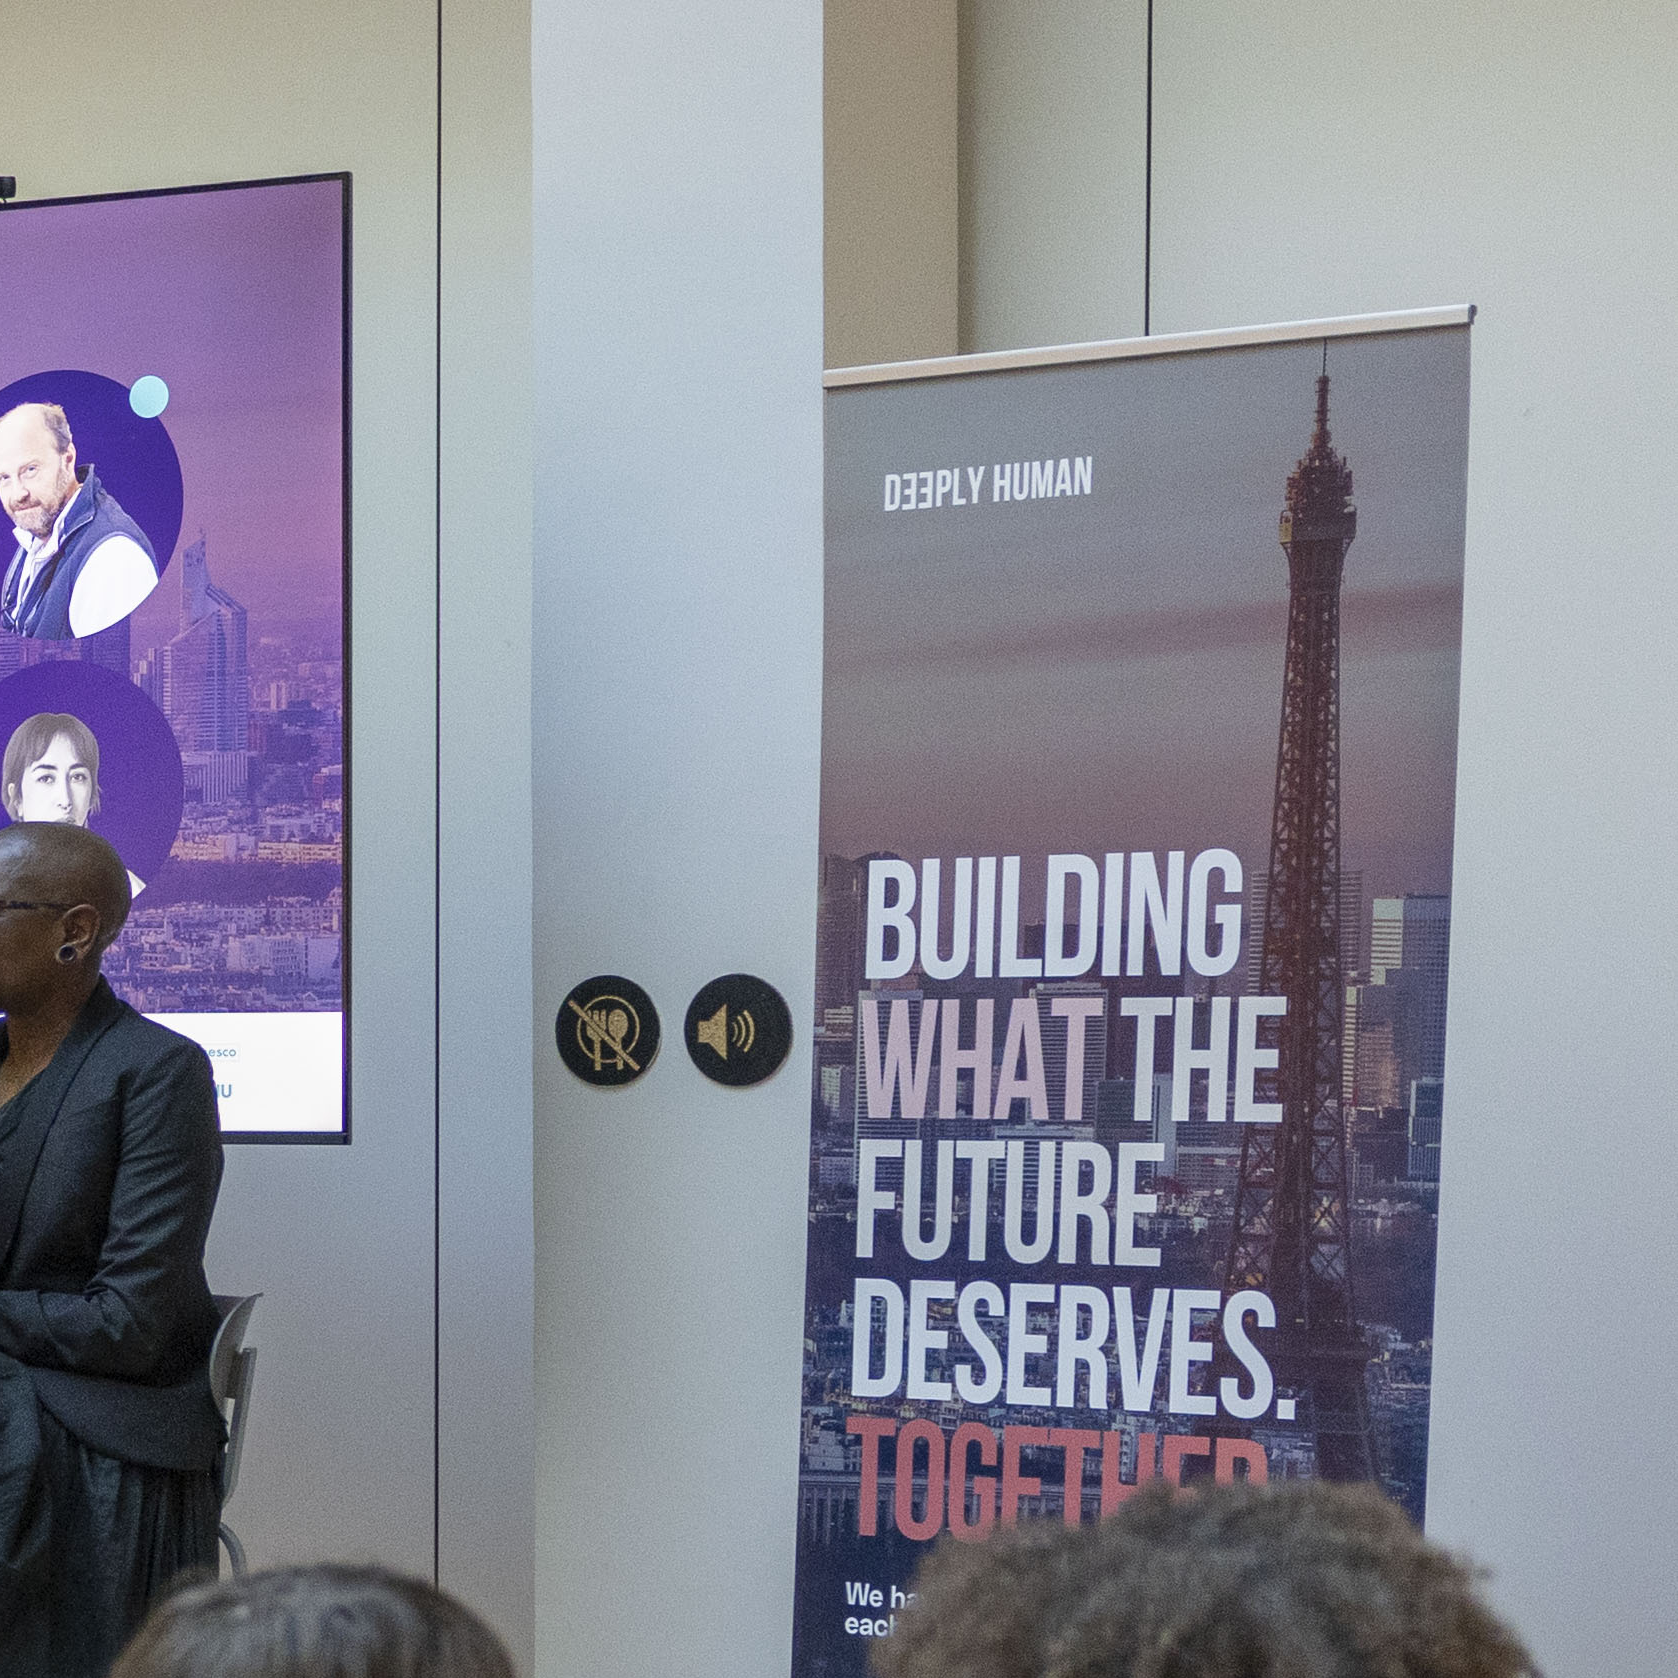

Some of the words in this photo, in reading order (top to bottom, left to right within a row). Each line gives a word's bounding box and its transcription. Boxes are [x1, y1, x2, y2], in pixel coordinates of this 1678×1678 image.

[993, 456, 1093, 503] HUMAN
[864, 848, 1243, 981] BUILDING
[861, 996, 1103, 1119] WHAT
[1120, 996, 1287, 1123] THE
[855, 1138, 1165, 1268] FUTURE
[851, 1276, 1297, 1422] DESERVES.
[845, 1581, 884, 1608] We
